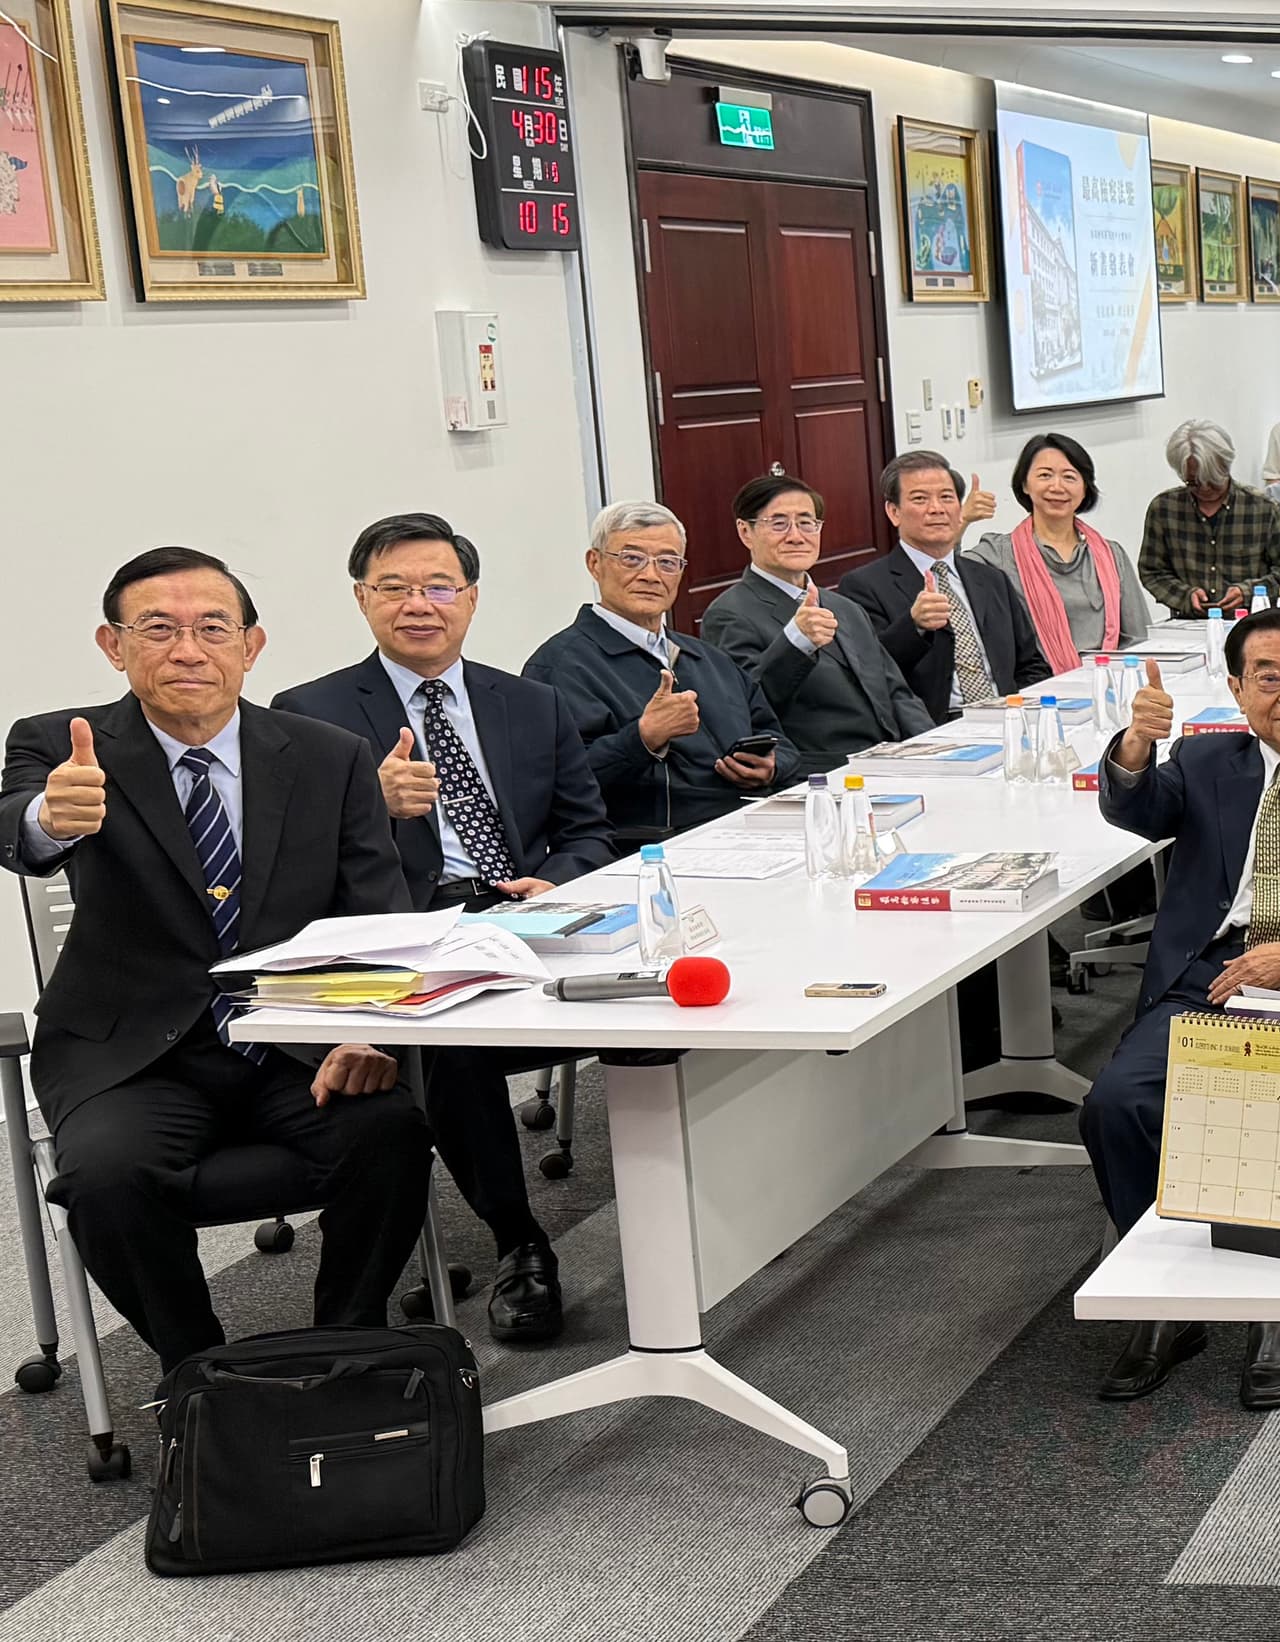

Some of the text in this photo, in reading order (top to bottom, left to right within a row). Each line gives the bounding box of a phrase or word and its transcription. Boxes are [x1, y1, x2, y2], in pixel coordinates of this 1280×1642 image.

[519, 201, 569, 235] 10 15
[1089, 250, 1135, 278] 新書發表會
[1182, 1036, 1194, 1048] 01
